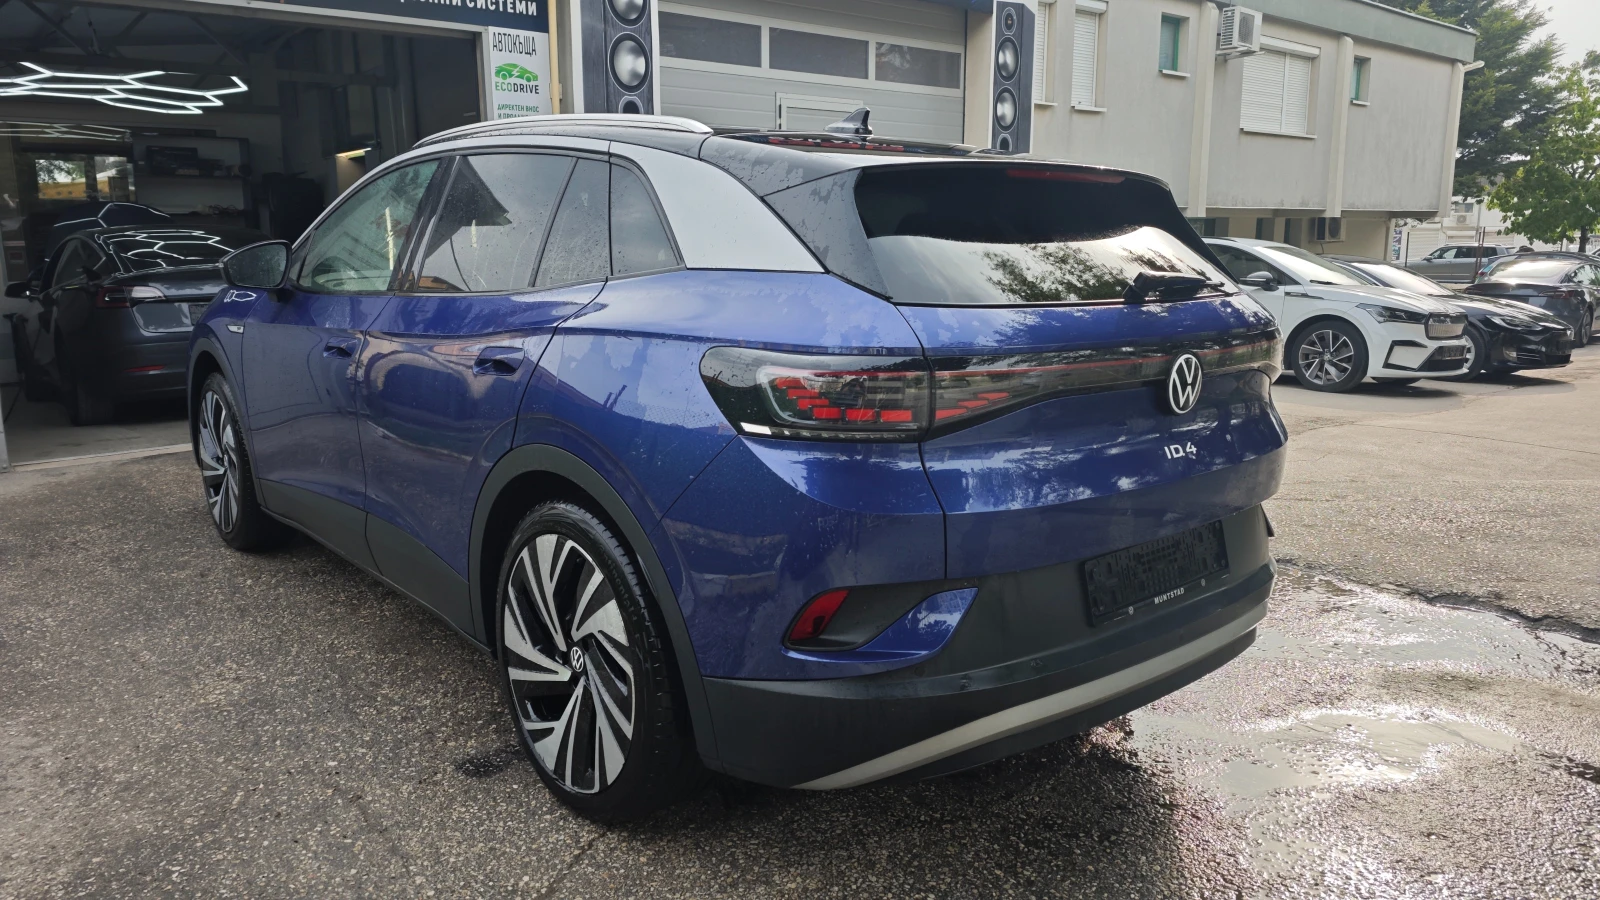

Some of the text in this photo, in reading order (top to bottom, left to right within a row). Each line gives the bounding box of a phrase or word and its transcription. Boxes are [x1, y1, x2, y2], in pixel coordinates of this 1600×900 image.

[466, 0, 538, 16] СИСТЕМИ
[492, 31, 537, 57] АВТОКЪЩА
[495, 81, 540, 95] ECODRIVE
[497, 103, 540, 113] ДИРЕКТЕН ВНОС
[1154, 587, 1185, 605] MUNTSTAD
